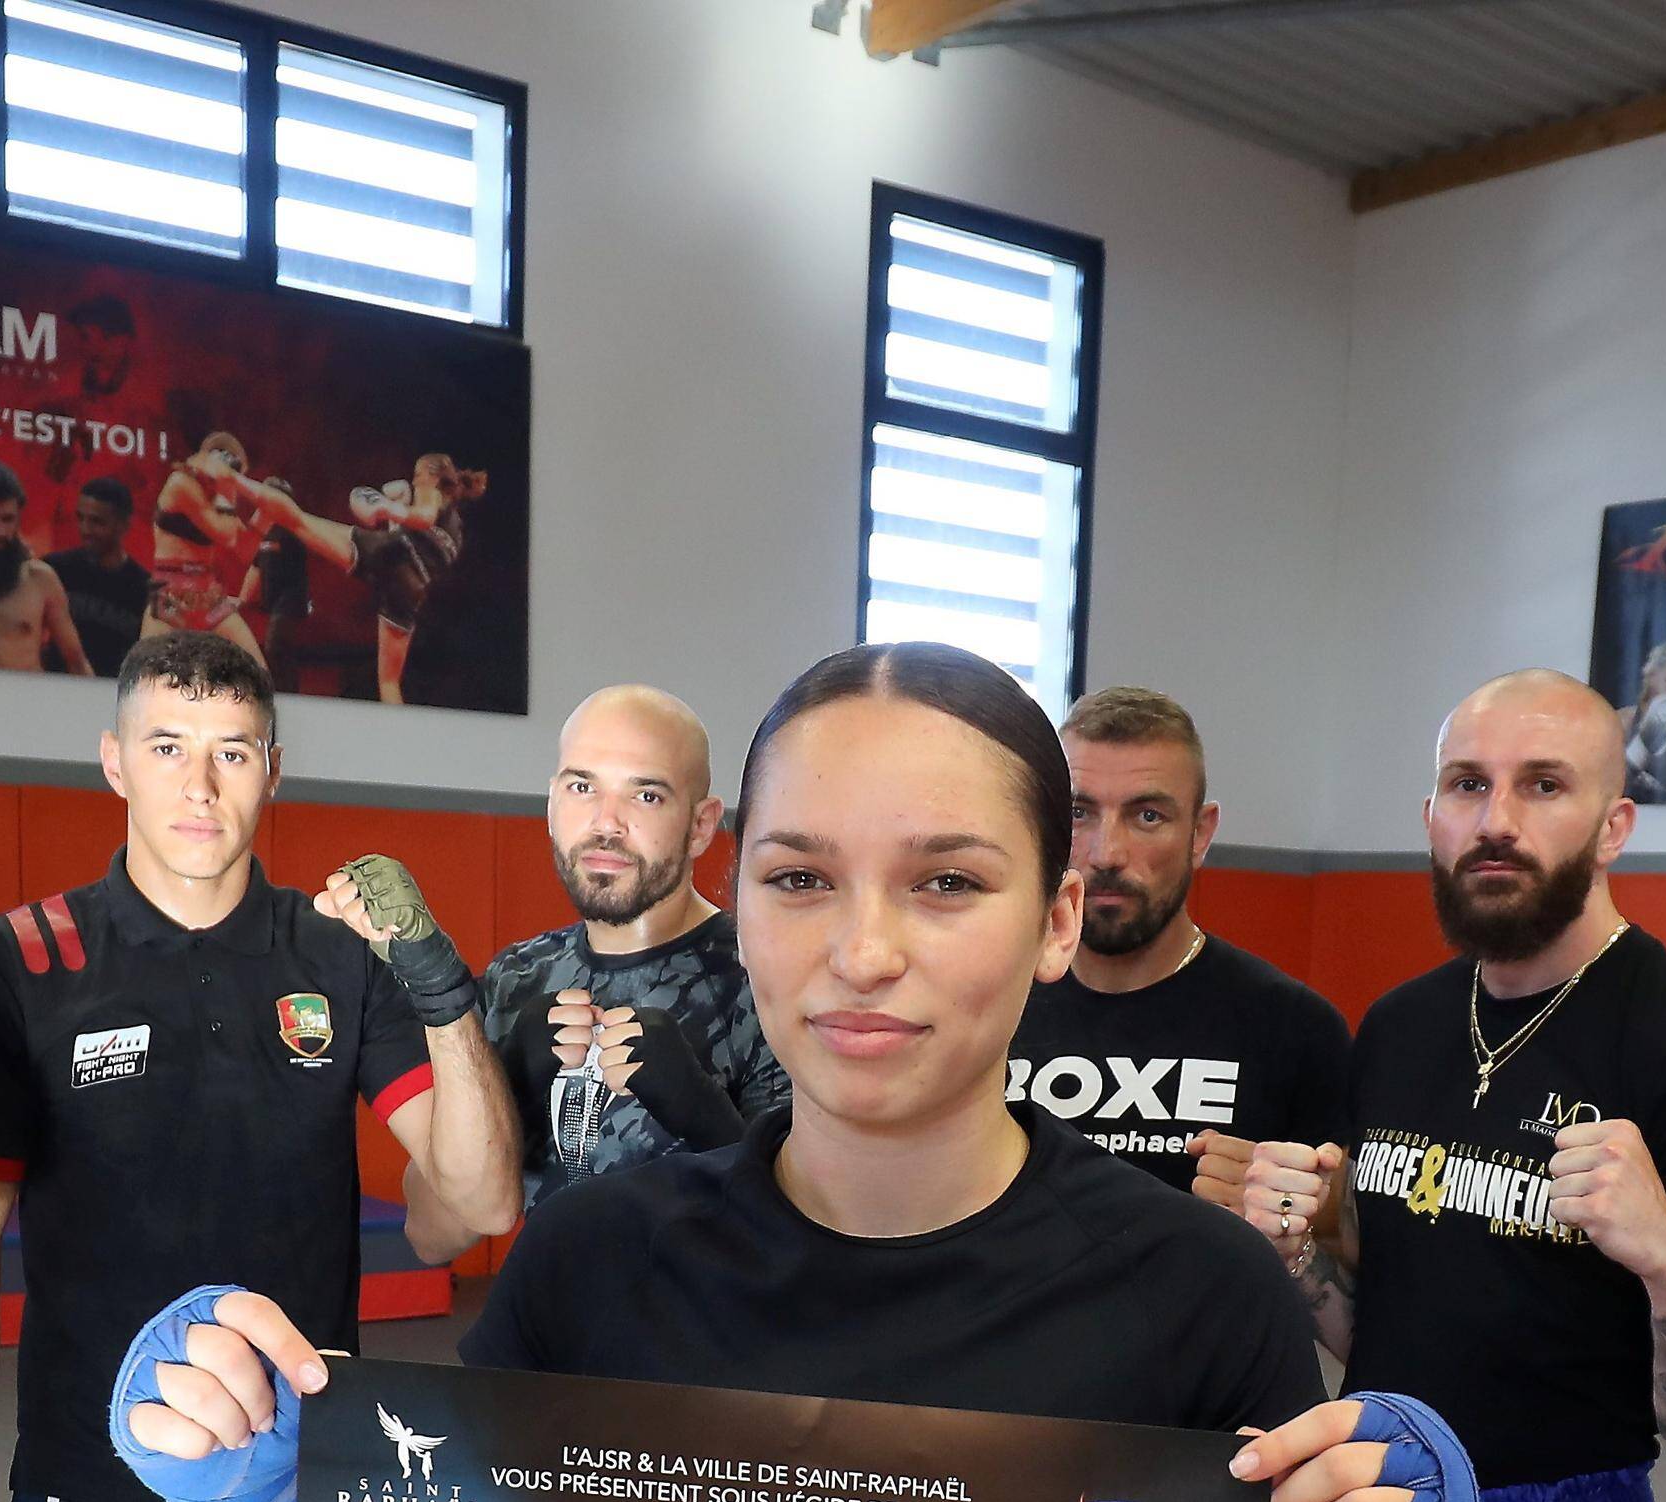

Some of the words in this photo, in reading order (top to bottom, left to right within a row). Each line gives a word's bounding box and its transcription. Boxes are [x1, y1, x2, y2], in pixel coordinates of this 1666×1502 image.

[87, 419, 145, 457] TOI
[158, 431, 168, 459] !
[76, 1058, 106, 1072] FIGHT
[108, 1052, 140, 1065] NIGHT
[80, 1061, 136, 1083] KI-PRO
[1366, 1128, 1430, 1147] TAEKWONDO
[1450, 1141, 1481, 1159] FULL
[1492, 1149, 1556, 1178] CONTA
[1354, 1141, 1424, 1199] FORCE
[1407, 1143, 1448, 1224] &
[1439, 1156, 1564, 1237] HONNEU
[358, 1478, 462, 1499] SAINT
[491, 1467, 552, 1492] VOUS
[562, 1446, 631, 1471] L'AJSR
[637, 1453, 654, 1472] &
[660, 1455, 687, 1476] LA
[692, 1457, 751, 1482] VILLE
[757, 1462, 787, 1484] DE
[794, 1466, 972, 1502] SAINT-RAPHAËL
